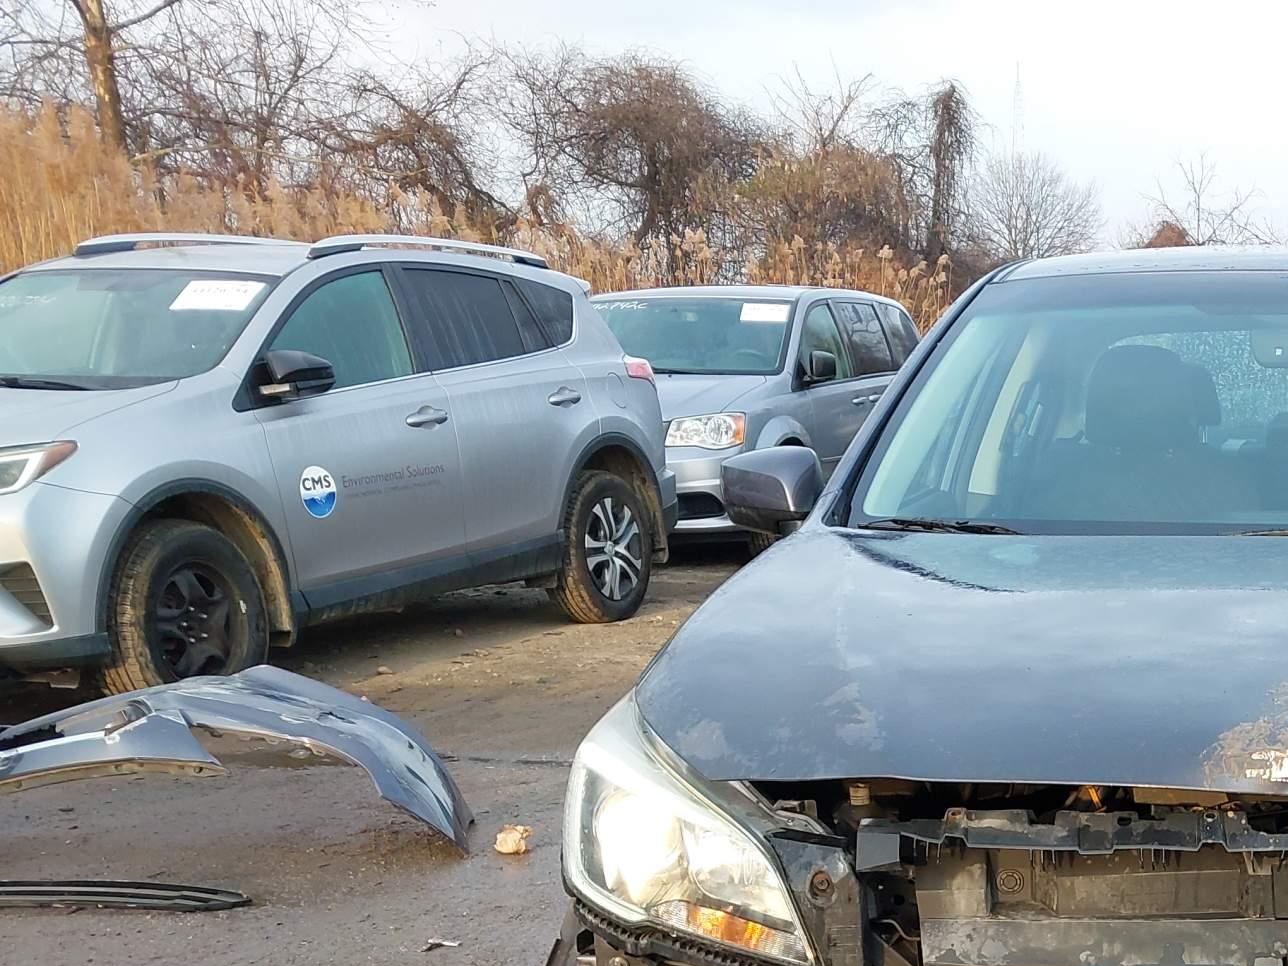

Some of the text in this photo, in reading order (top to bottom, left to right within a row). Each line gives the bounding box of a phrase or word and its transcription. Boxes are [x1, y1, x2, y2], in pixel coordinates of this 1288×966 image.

[302, 475, 331, 491] CMS
[341, 463, 445, 488] Environmental Solutions
